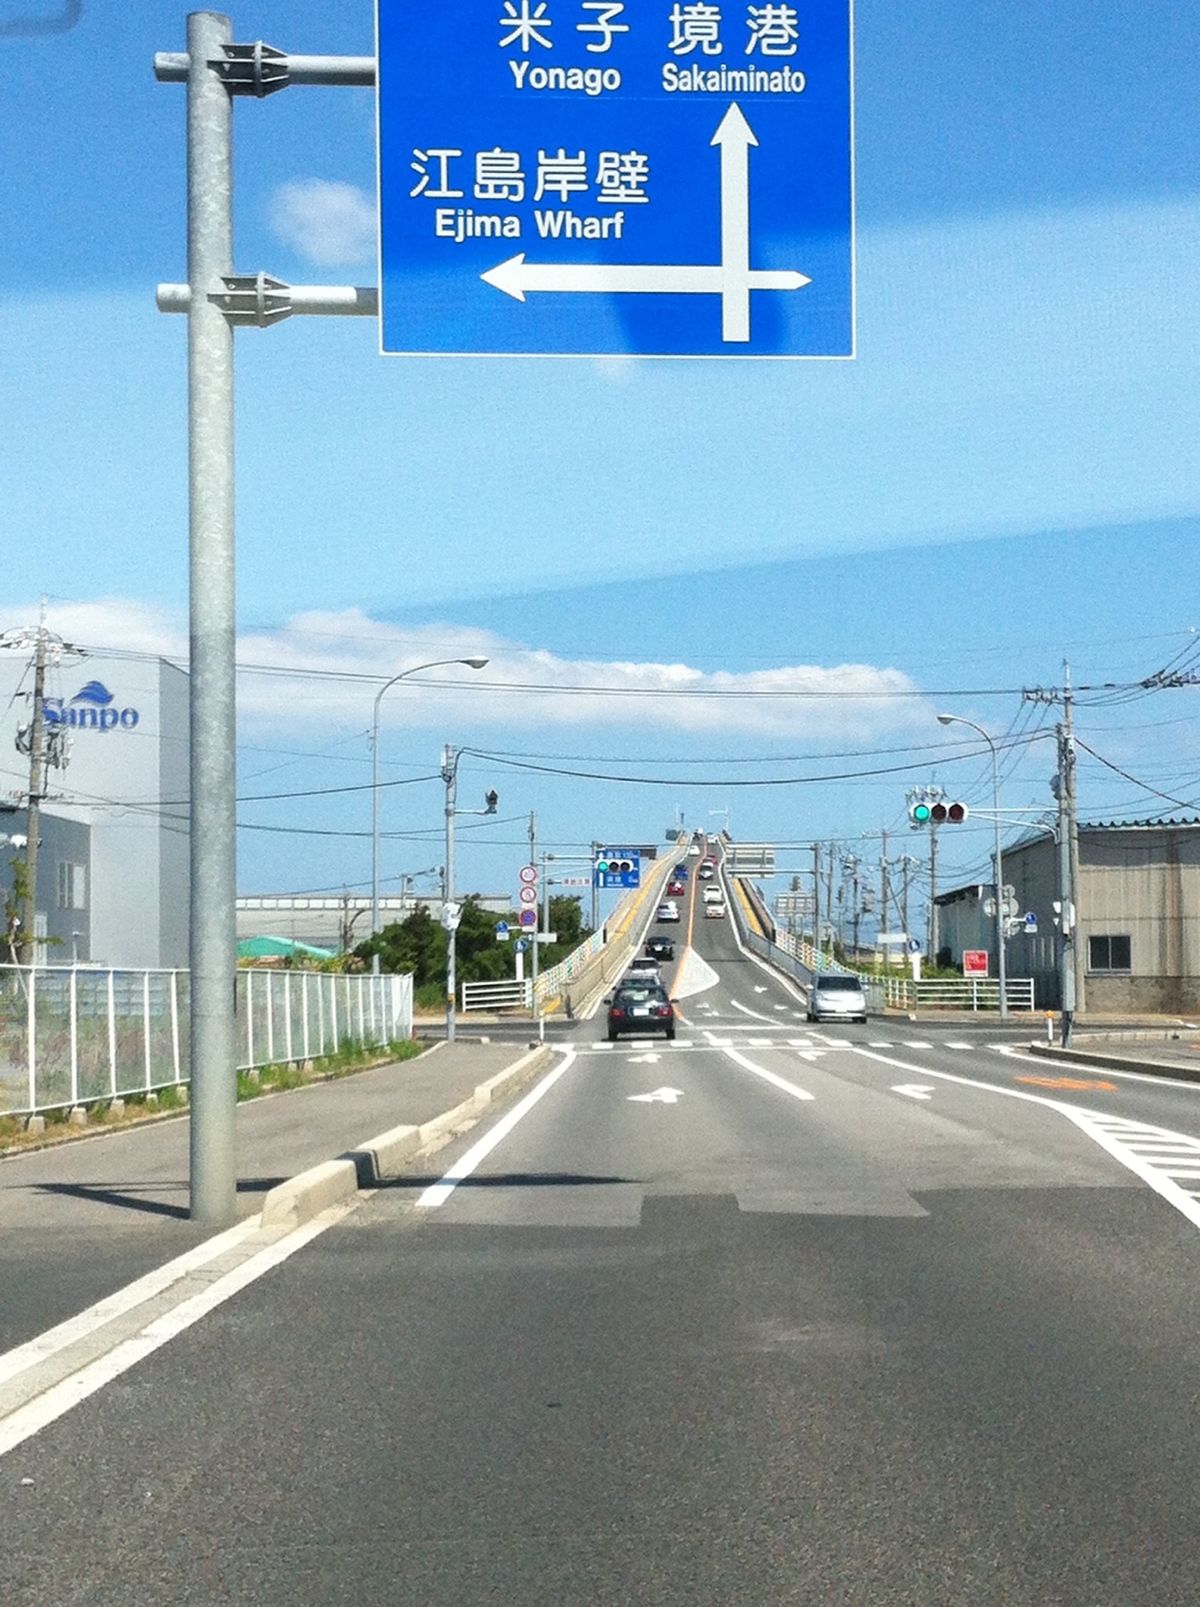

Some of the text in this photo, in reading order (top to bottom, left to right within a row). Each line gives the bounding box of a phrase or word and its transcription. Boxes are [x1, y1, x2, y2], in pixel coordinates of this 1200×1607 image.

[498, 0, 630, 52] 米子
[667, 2, 800, 55] 境港
[508, 60, 622, 96] Yonago
[661, 62, 806, 93] Sakaiminato
[409, 147, 649, 203] 江島岸壁
[435, 208, 625, 243] Ejima Wharf
[43, 697, 140, 732] Sanpo
